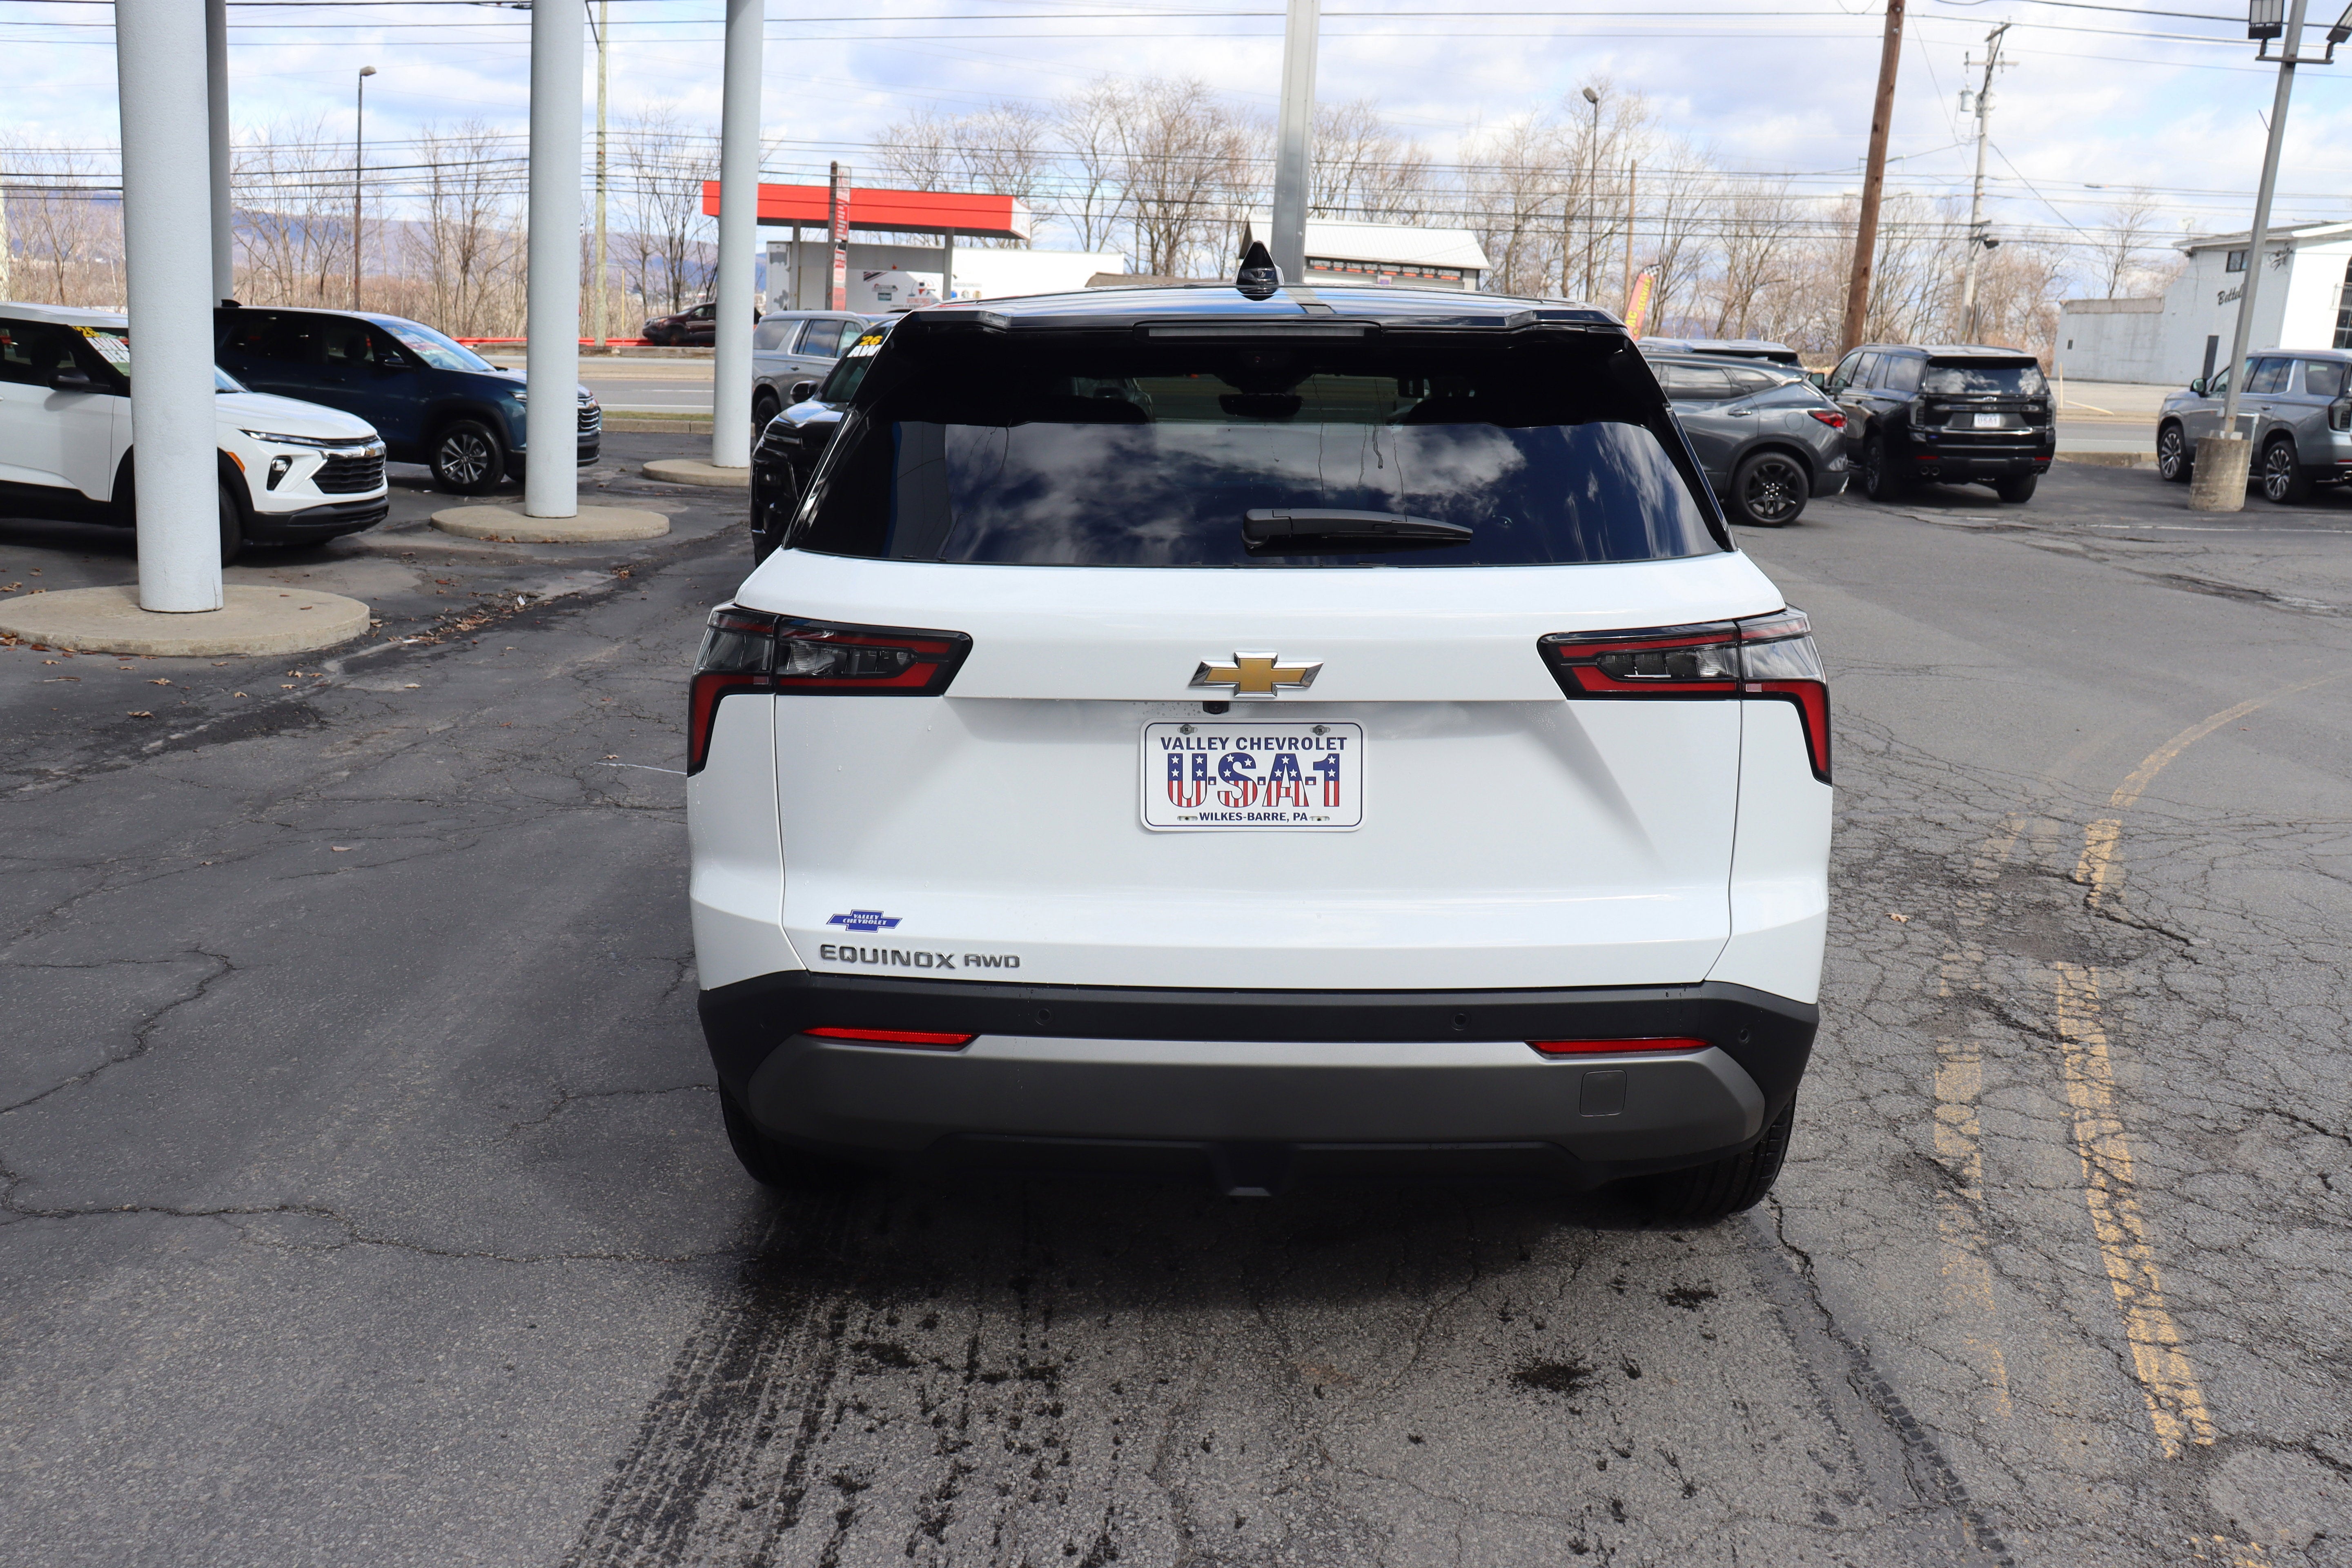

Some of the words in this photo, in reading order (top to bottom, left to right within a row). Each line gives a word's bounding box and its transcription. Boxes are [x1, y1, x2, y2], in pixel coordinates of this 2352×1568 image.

[1625, 310, 1638, 327] AC
[1637, 277, 1652, 312] SERVICE
[85, 337, 129, 351] AWD
[847, 344, 882, 357] AW
[1160, 737, 1230, 750] VALLEY
[1236, 737, 1347, 751] CHEVROLET
[1199, 812, 1290, 822] WILKES-BARRE,
[1294, 813, 1308, 821] PA
[820, 944, 956, 969] EQUINOX
[964, 953, 1020, 968] AWD
